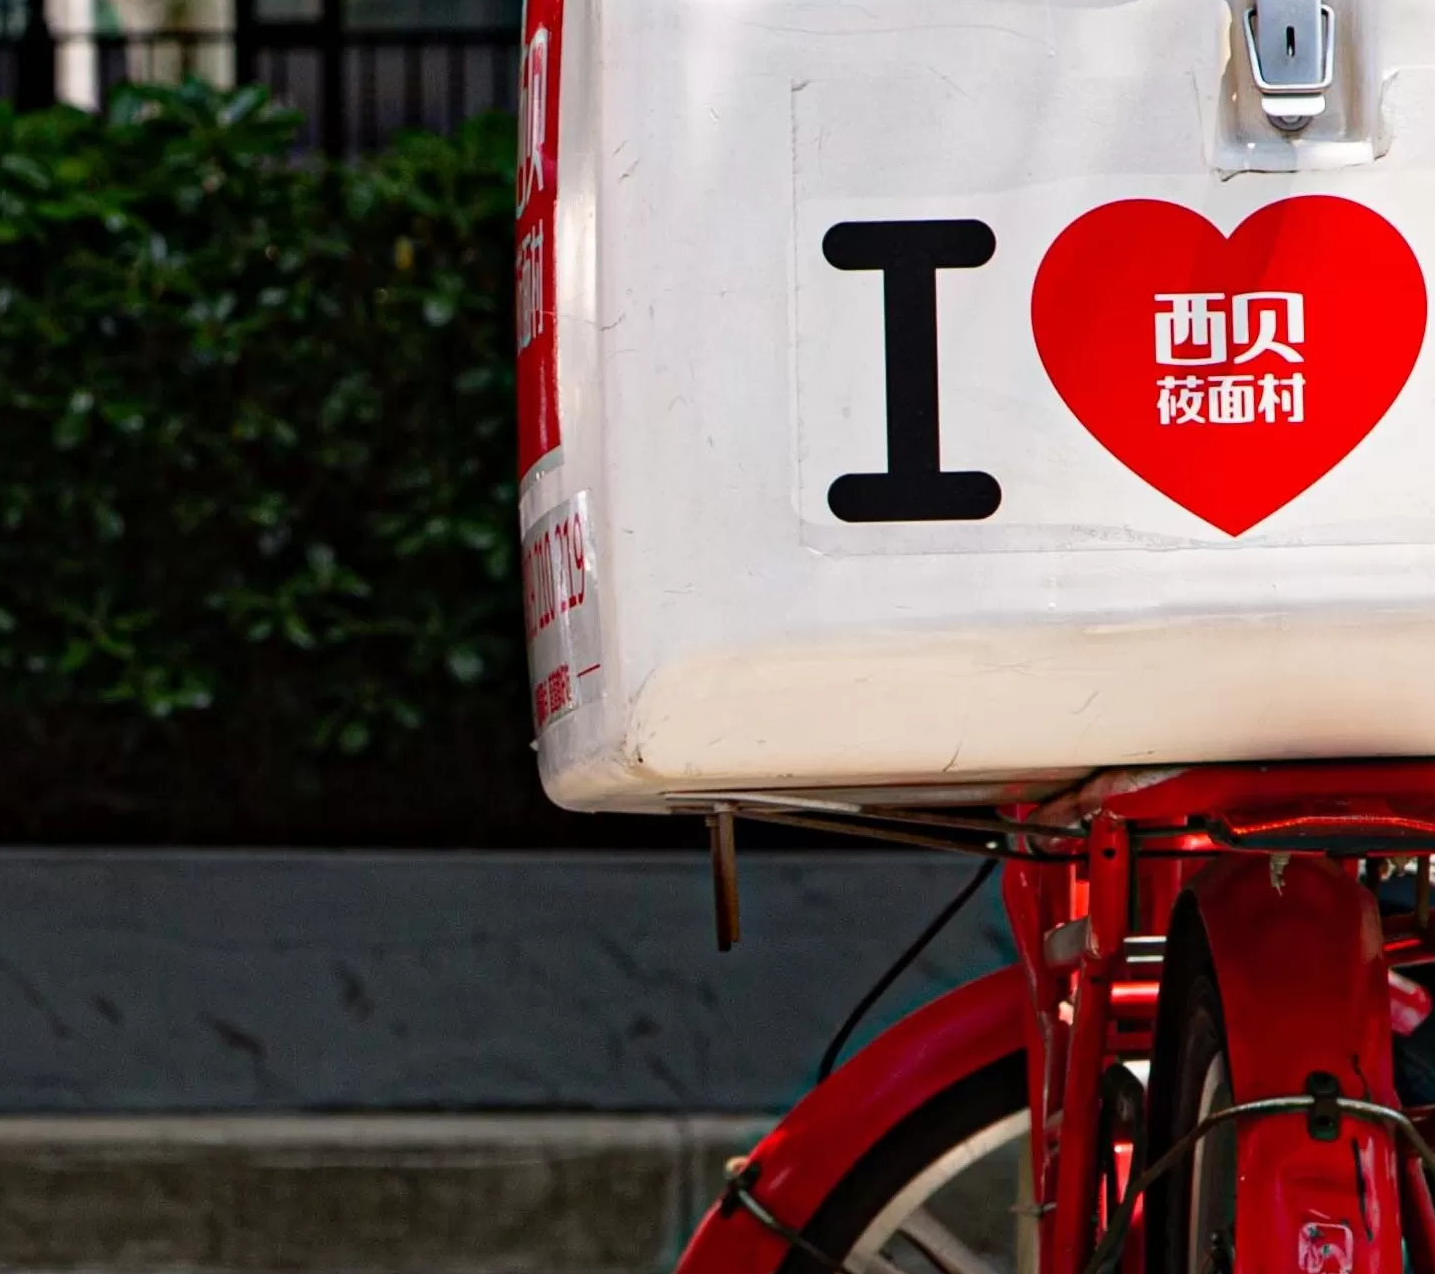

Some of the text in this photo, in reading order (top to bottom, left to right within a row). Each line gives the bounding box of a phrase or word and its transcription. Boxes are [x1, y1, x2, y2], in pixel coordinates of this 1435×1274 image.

[1153, 290, 1306, 367] 西贝
[821, 218, 1003, 524] I
[1154, 371, 1307, 426] 莜面村
